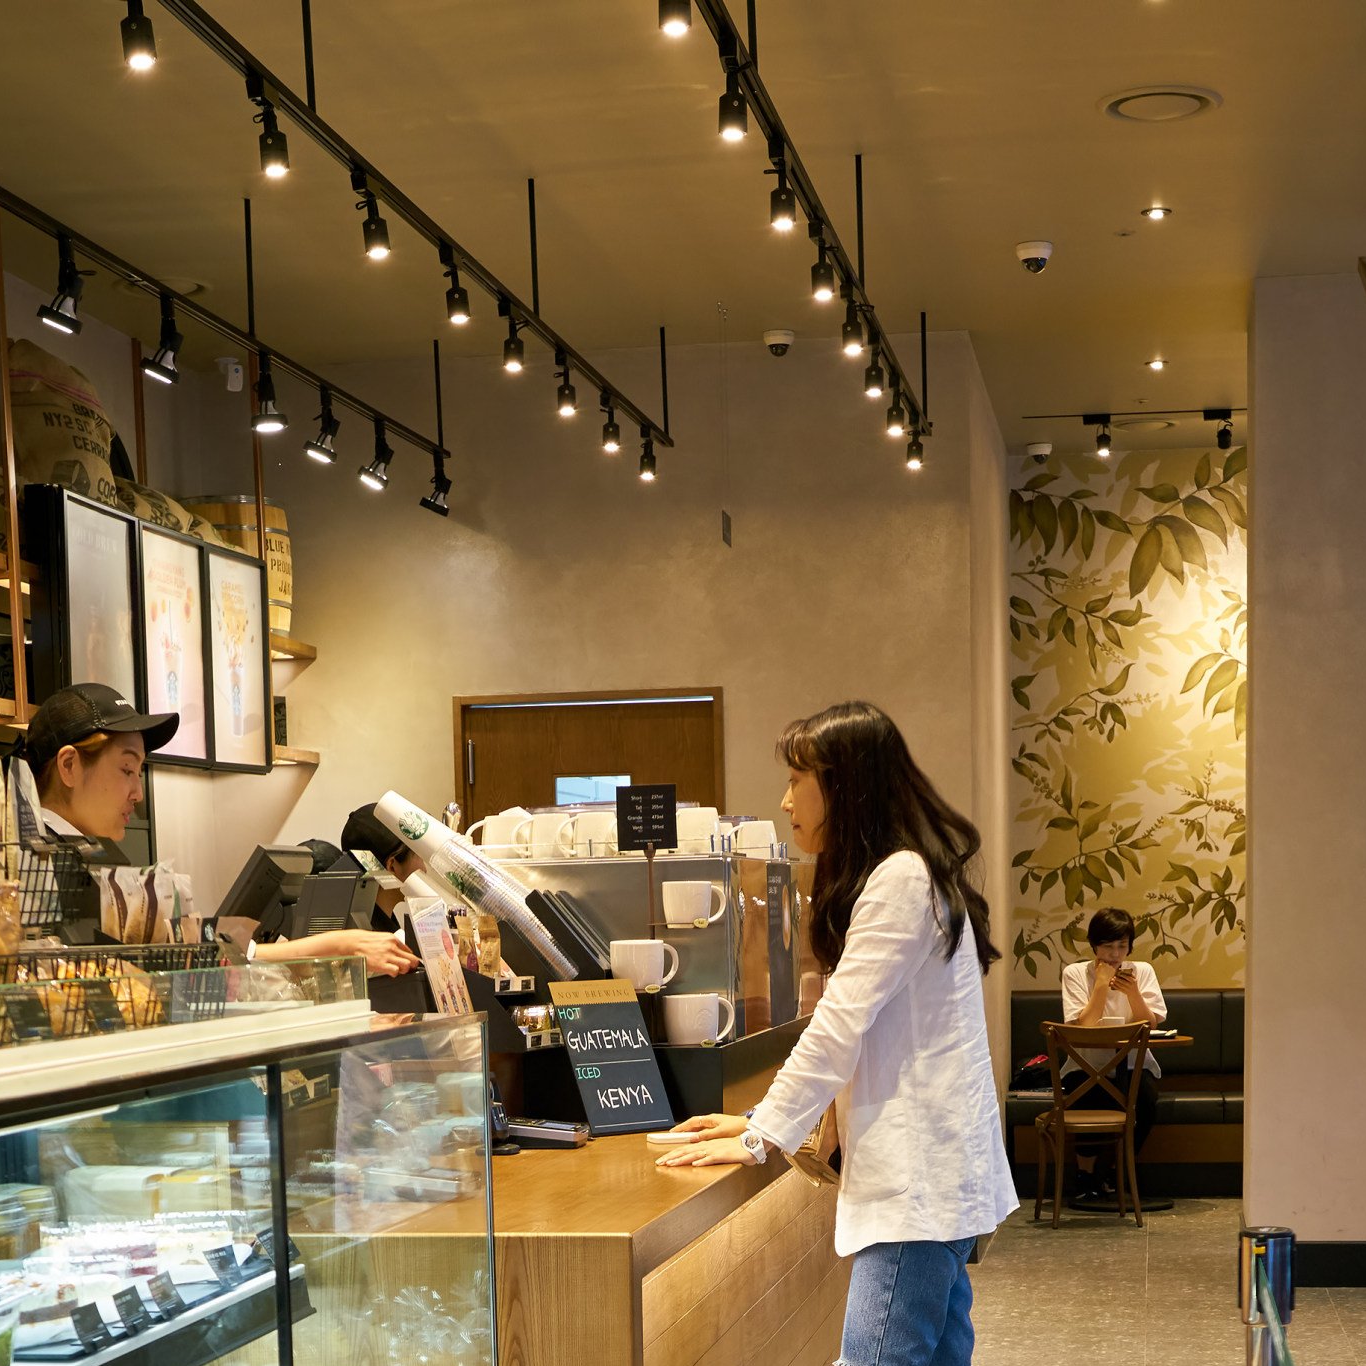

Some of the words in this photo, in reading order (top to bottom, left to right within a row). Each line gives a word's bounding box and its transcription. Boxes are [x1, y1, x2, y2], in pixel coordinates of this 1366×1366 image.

[584, 989, 630, 998] BREWING
[558, 1007, 580, 1020] HOT
[567, 1028, 649, 1053] GUATEMALA
[575, 1067, 601, 1079] ICED
[597, 1084, 653, 1109] KENYA
